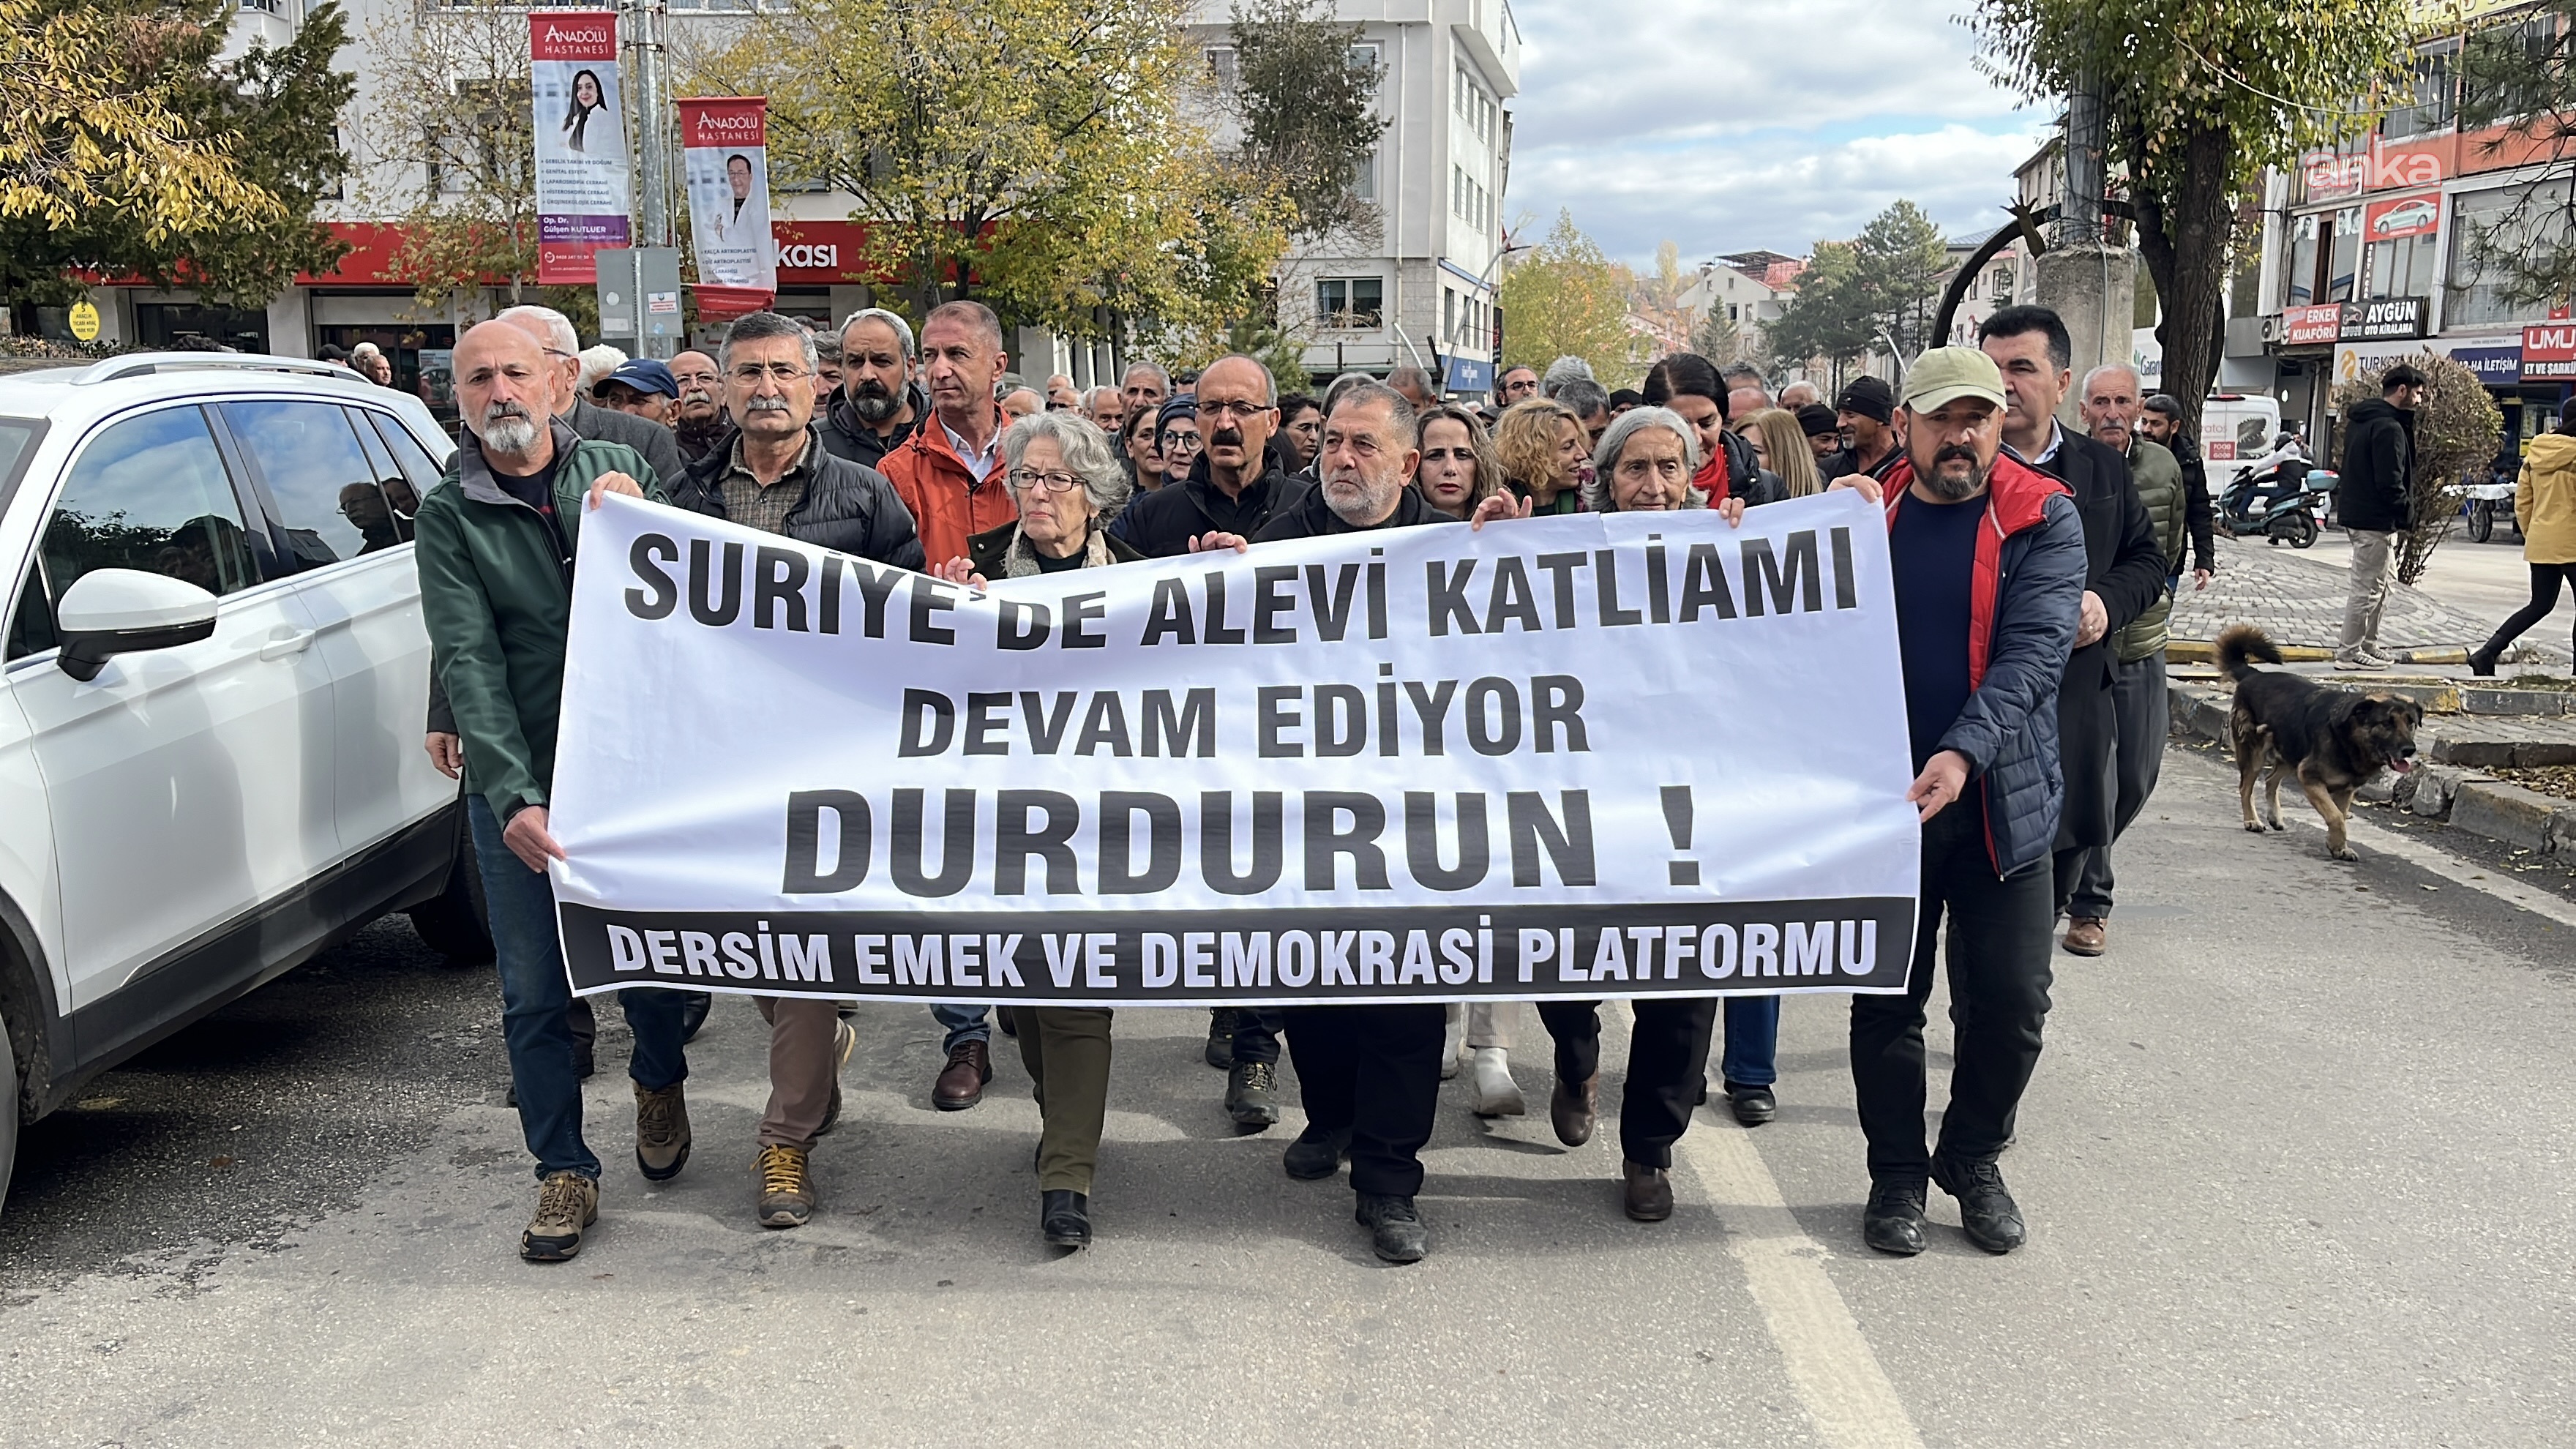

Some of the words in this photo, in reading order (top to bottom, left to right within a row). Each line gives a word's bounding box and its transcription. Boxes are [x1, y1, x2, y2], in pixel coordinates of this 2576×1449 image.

[544, 24, 607, 42] ANADOLU
[545, 43, 608, 54] HASTANESİ
[696, 111, 757, 130] ANADOLU
[697, 130, 760, 141] HASTANESİ
[544, 226, 569, 234] Gülşen
[2307, 307, 2338, 323] ERKEK
[2366, 301, 2417, 323] AYGÜN
[2292, 324, 2336, 341] KUAFÖRÜ
[2365, 324, 2378, 336] OTO
[2379, 323, 2414, 334] KİRALAMA
[2484, 356, 2517, 374] İLETİŞİM
[2524, 363, 2535, 375] ET
[2536, 363, 2546, 375] VE
[1140, 547, 1388, 646] ALEVİ
[1426, 526, 1857, 637] KATLİAMI
[898, 687, 1216, 759] DEVAM
[1257, 662, 1592, 758] EDİYOR
[782, 787, 1597, 897] DURDURUN
[1660, 785, 1701, 886] !
[606, 920, 834, 984] DERSİM
[855, 933, 1025, 987] EMEK
[1041, 933, 1117, 988] VE
[1140, 914, 1494, 988] DEMOKRASİ
[1517, 919, 1877, 983] PLATFORMU
